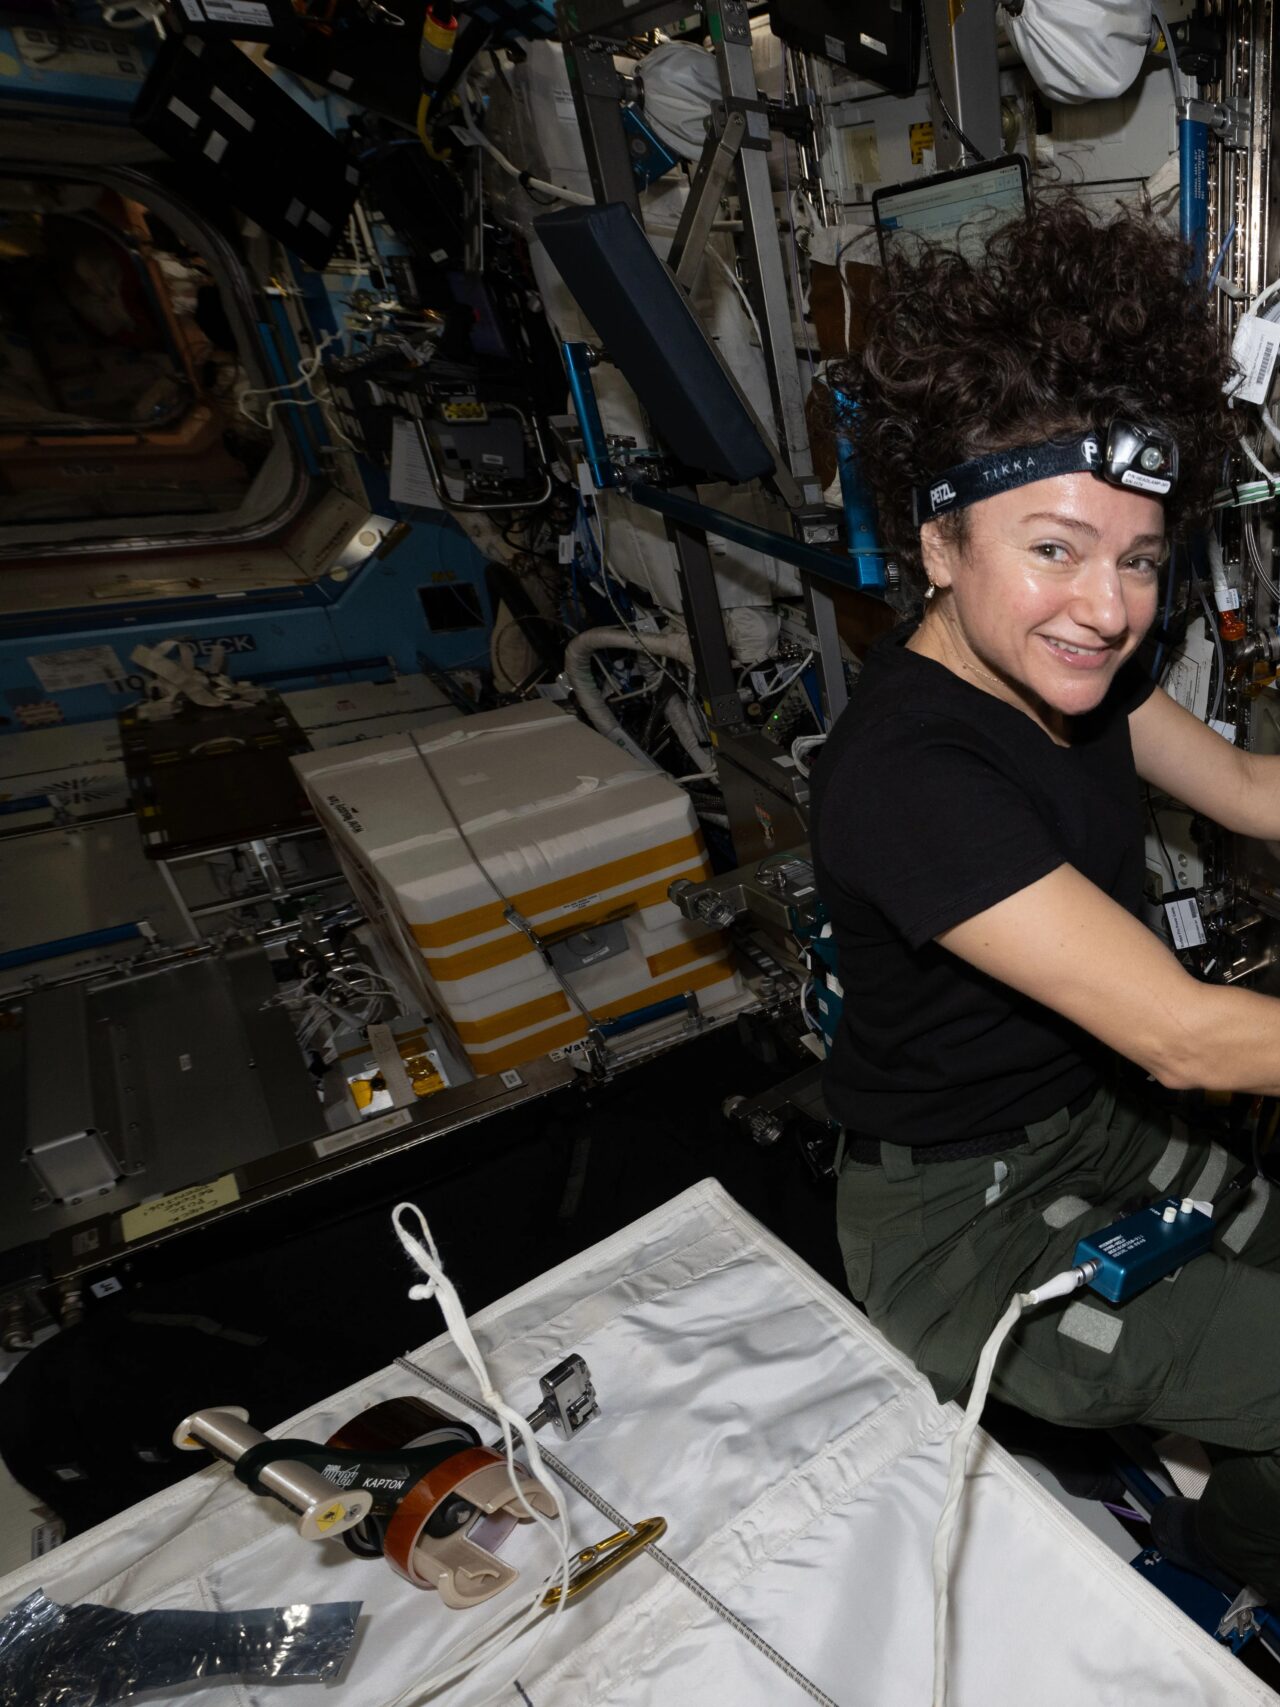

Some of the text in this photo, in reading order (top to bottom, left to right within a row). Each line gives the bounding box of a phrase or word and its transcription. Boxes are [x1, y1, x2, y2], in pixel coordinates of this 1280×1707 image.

[983, 458, 1036, 481] TIKKA
[930, 482, 956, 512] PETZL
[362, 1478, 406, 1490] KAPTON
